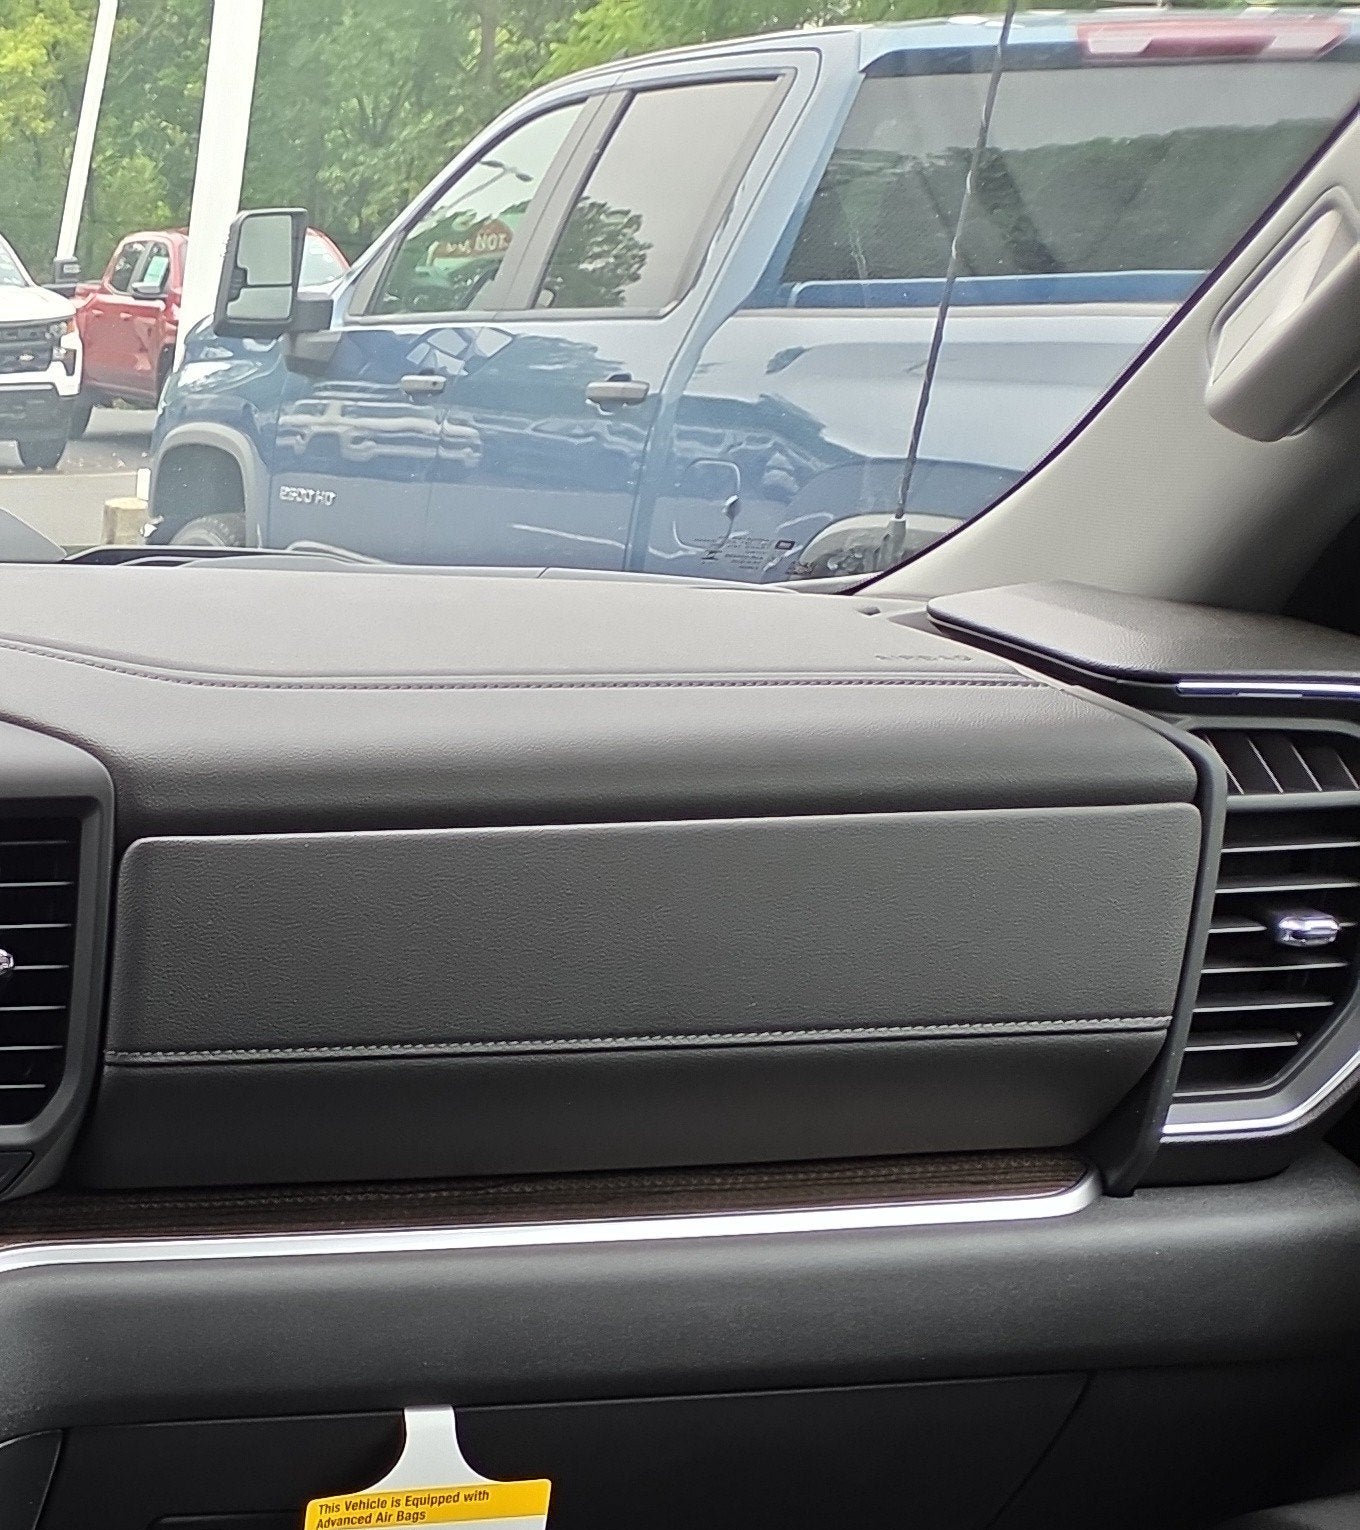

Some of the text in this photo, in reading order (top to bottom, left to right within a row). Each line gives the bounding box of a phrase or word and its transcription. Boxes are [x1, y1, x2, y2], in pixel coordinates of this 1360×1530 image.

[318, 1489, 490, 1516] This Vehicle is Equipped with
[315, 1510, 427, 1530] Advanced Air Bags
